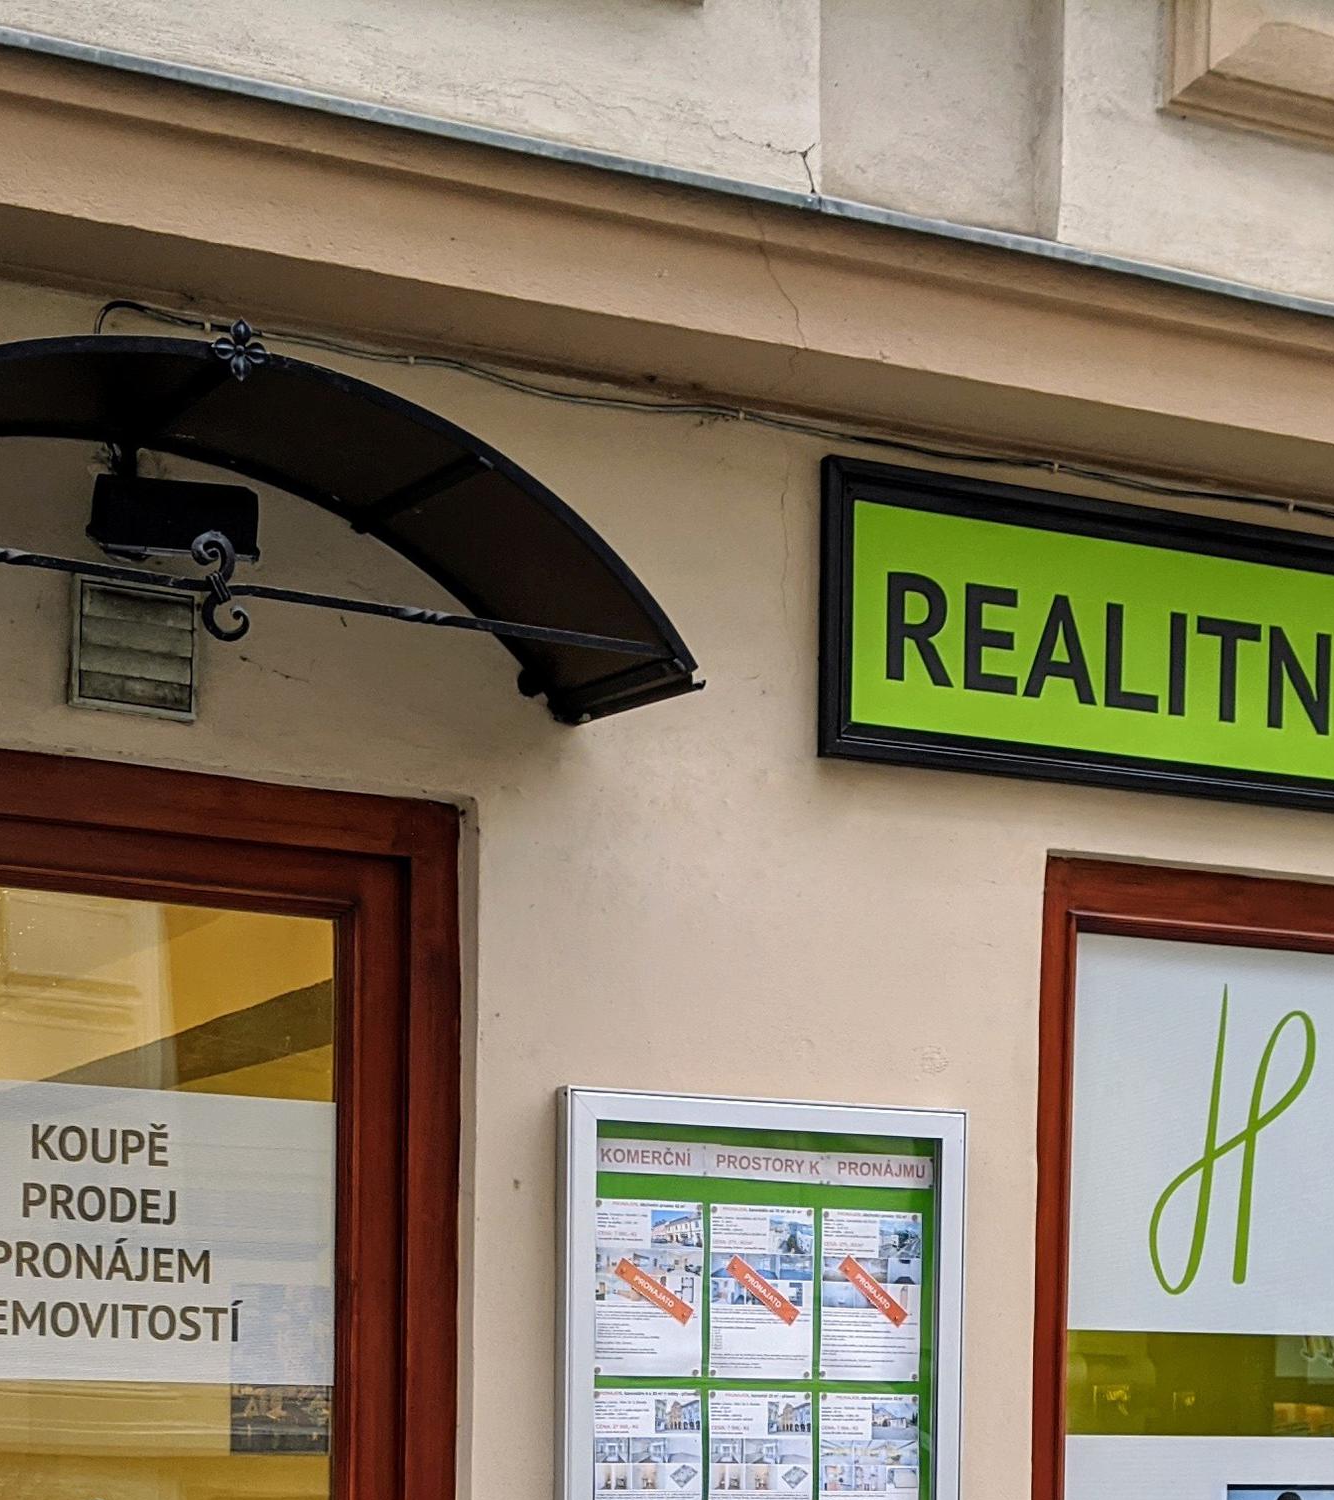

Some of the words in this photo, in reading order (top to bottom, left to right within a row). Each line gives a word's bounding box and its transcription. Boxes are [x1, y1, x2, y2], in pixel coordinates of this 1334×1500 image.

[31, 1123, 169, 1167] KOUPĚ
[600, 1147, 691, 1167] KOMERČNÍ
[716, 1154, 802, 1174] PROSTORY
[810, 1160, 820, 1175] K
[837, 1159, 925, 1179] PRONÁJMU
[22, 1182, 177, 1225] PRODEJ
